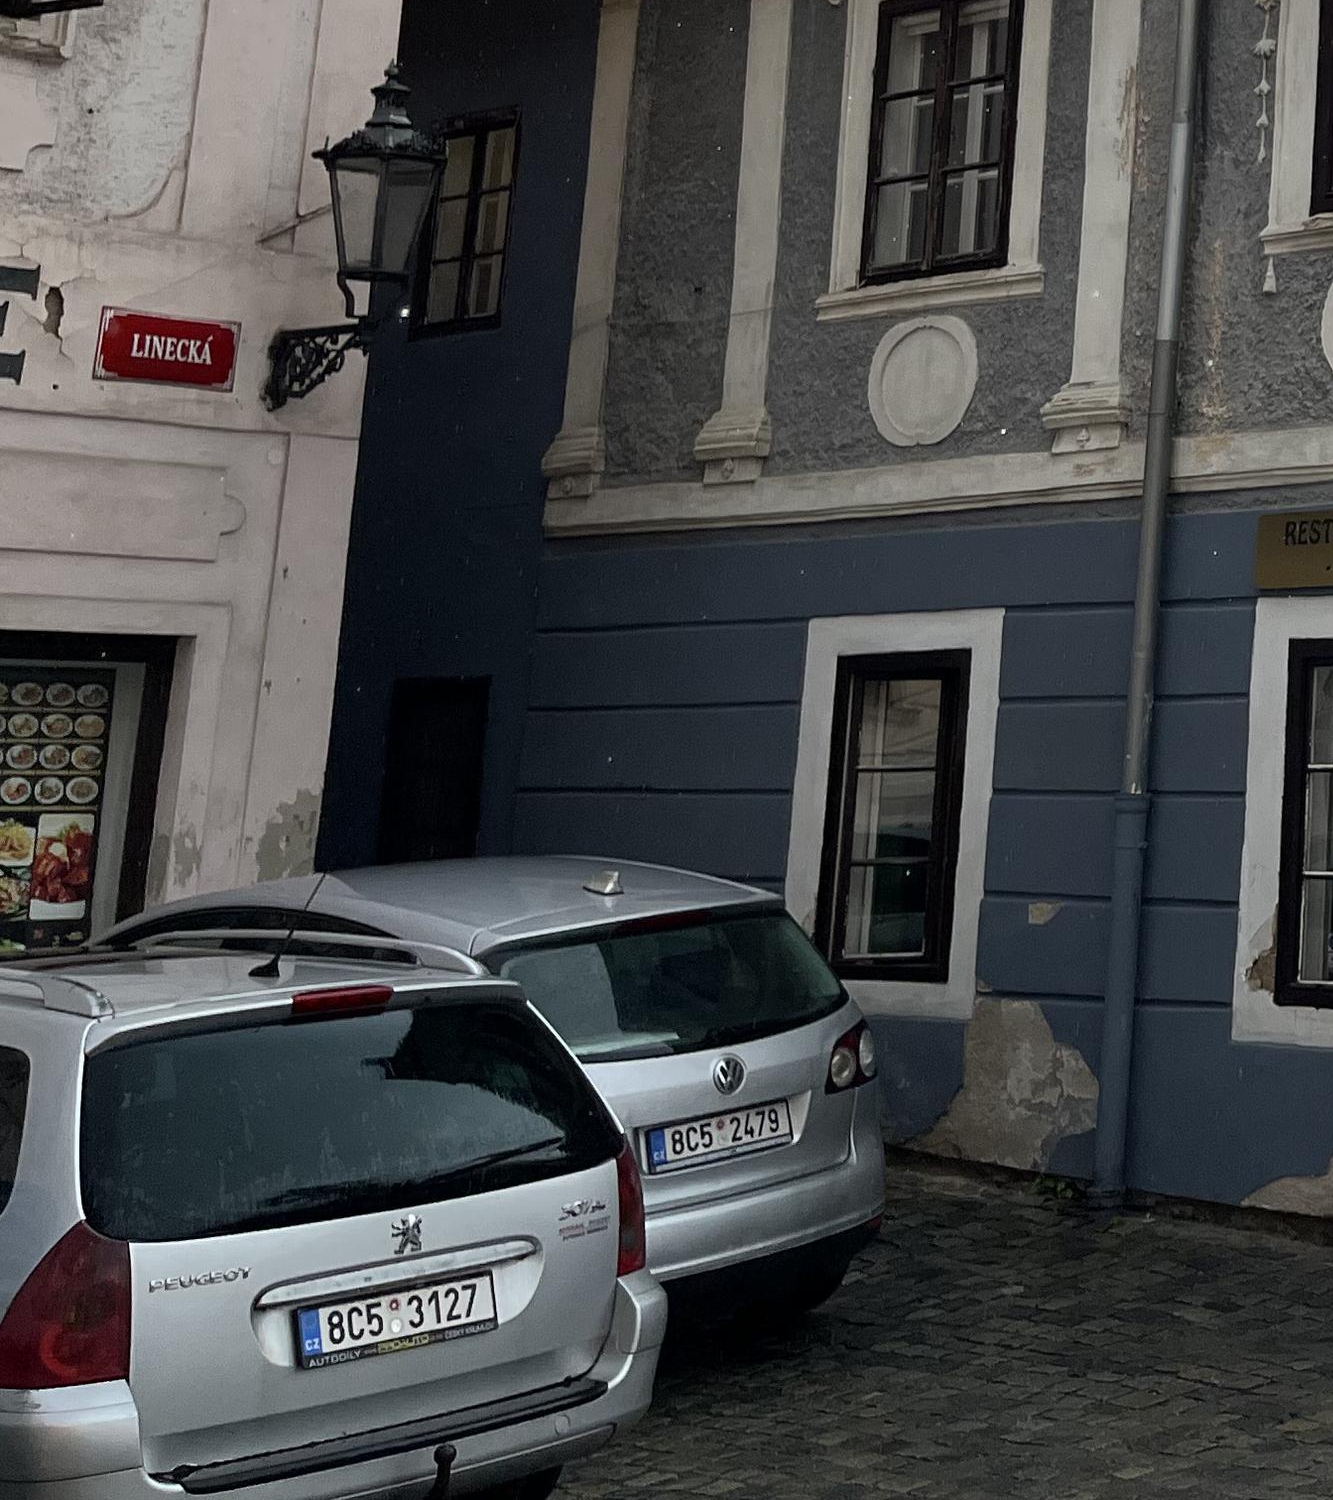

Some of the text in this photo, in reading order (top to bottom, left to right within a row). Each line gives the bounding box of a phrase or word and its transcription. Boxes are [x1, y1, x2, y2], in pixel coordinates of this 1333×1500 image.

[131, 333, 212, 365] LINECKÁ
[671, 1108, 779, 1155] 8C5 2479
[149, 1266, 251, 1293] PEUGEOT
[327, 1302, 384, 1345] 8C5
[407, 1283, 477, 1329] 3127
[305, 1338, 320, 1351] CZ
